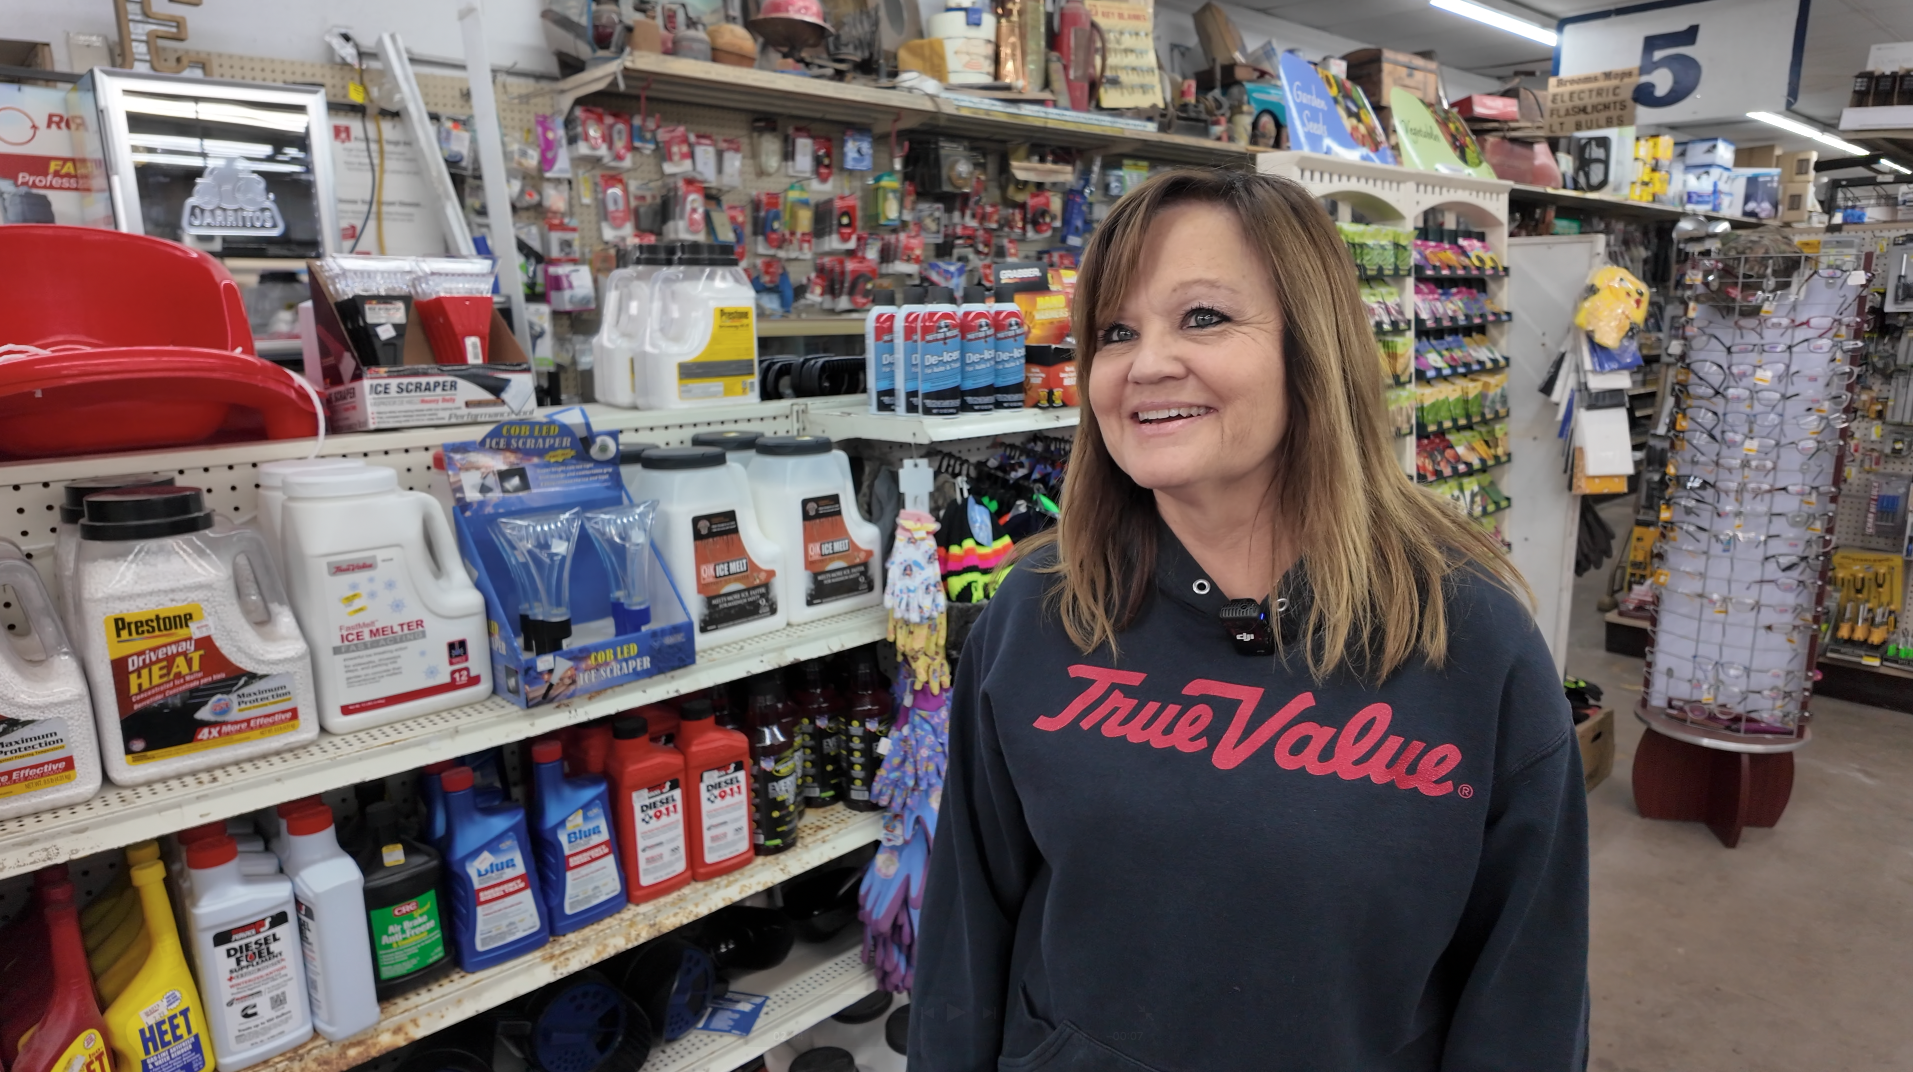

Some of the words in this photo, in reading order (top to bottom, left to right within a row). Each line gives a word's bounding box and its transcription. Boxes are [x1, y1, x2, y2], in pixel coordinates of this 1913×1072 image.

[1632, 24, 1702, 108] 5
[1293, 81, 1328, 111] Garden
[1551, 86, 1621, 105] ELECTRIC
[1549, 100, 1627, 118] FLASHLIGHTS
[1303, 110, 1328, 136] Seeds
[1575, 115, 1624, 131] BULBS
[189, 206, 275, 229] JARRITOS
[369, 382, 391, 395] ICE
[396, 380, 458, 394] SCRAPER
[502, 425, 530, 436] COB
[534, 425, 559, 436] LED
[485, 437, 507, 449] ICE
[511, 437, 571, 449] SCRAPER
[821, 542, 833, 555] ICE
[833, 539, 849, 552] MELT
[715, 562, 729, 578] ICE
[729, 558, 747, 574] MELT
[113, 612, 193, 639] Prestone
[340, 630, 365, 643] ICE
[369, 619, 425, 639] MELTER
[1236, 632, 1255, 642] dji
[127, 638, 195, 672] Driveway
[590, 648, 614, 666] COB
[616, 642, 638, 660] LED
[128, 649, 205, 696] HEAT
[453, 670, 468, 682] 12
[580, 669, 598, 685] ICE
[600, 655, 651, 680] SCRAPER
[236, 685, 286, 699] Maximum
[237, 690, 291, 707] Protection
[197, 726, 220, 740] 4X
[221, 722, 248, 734] More
[250, 711, 292, 728] Effective
[12, 761, 66, 779] Effective
[706, 776, 741, 792] DIESEL
[640, 794, 677, 813] DIESEL
[566, 825, 602, 844] Blue
[394, 901, 418, 916] CRC
[381, 919, 436, 945] Anti-Freeze
[388, 924, 402, 934] Air
[403, 914, 428, 930] Brake
[226, 932, 281, 959] DIESEL
[229, 951, 283, 974] SUPPLEMENT
[235, 946, 275, 967] FUEL
[138, 1006, 193, 1056] HEET
